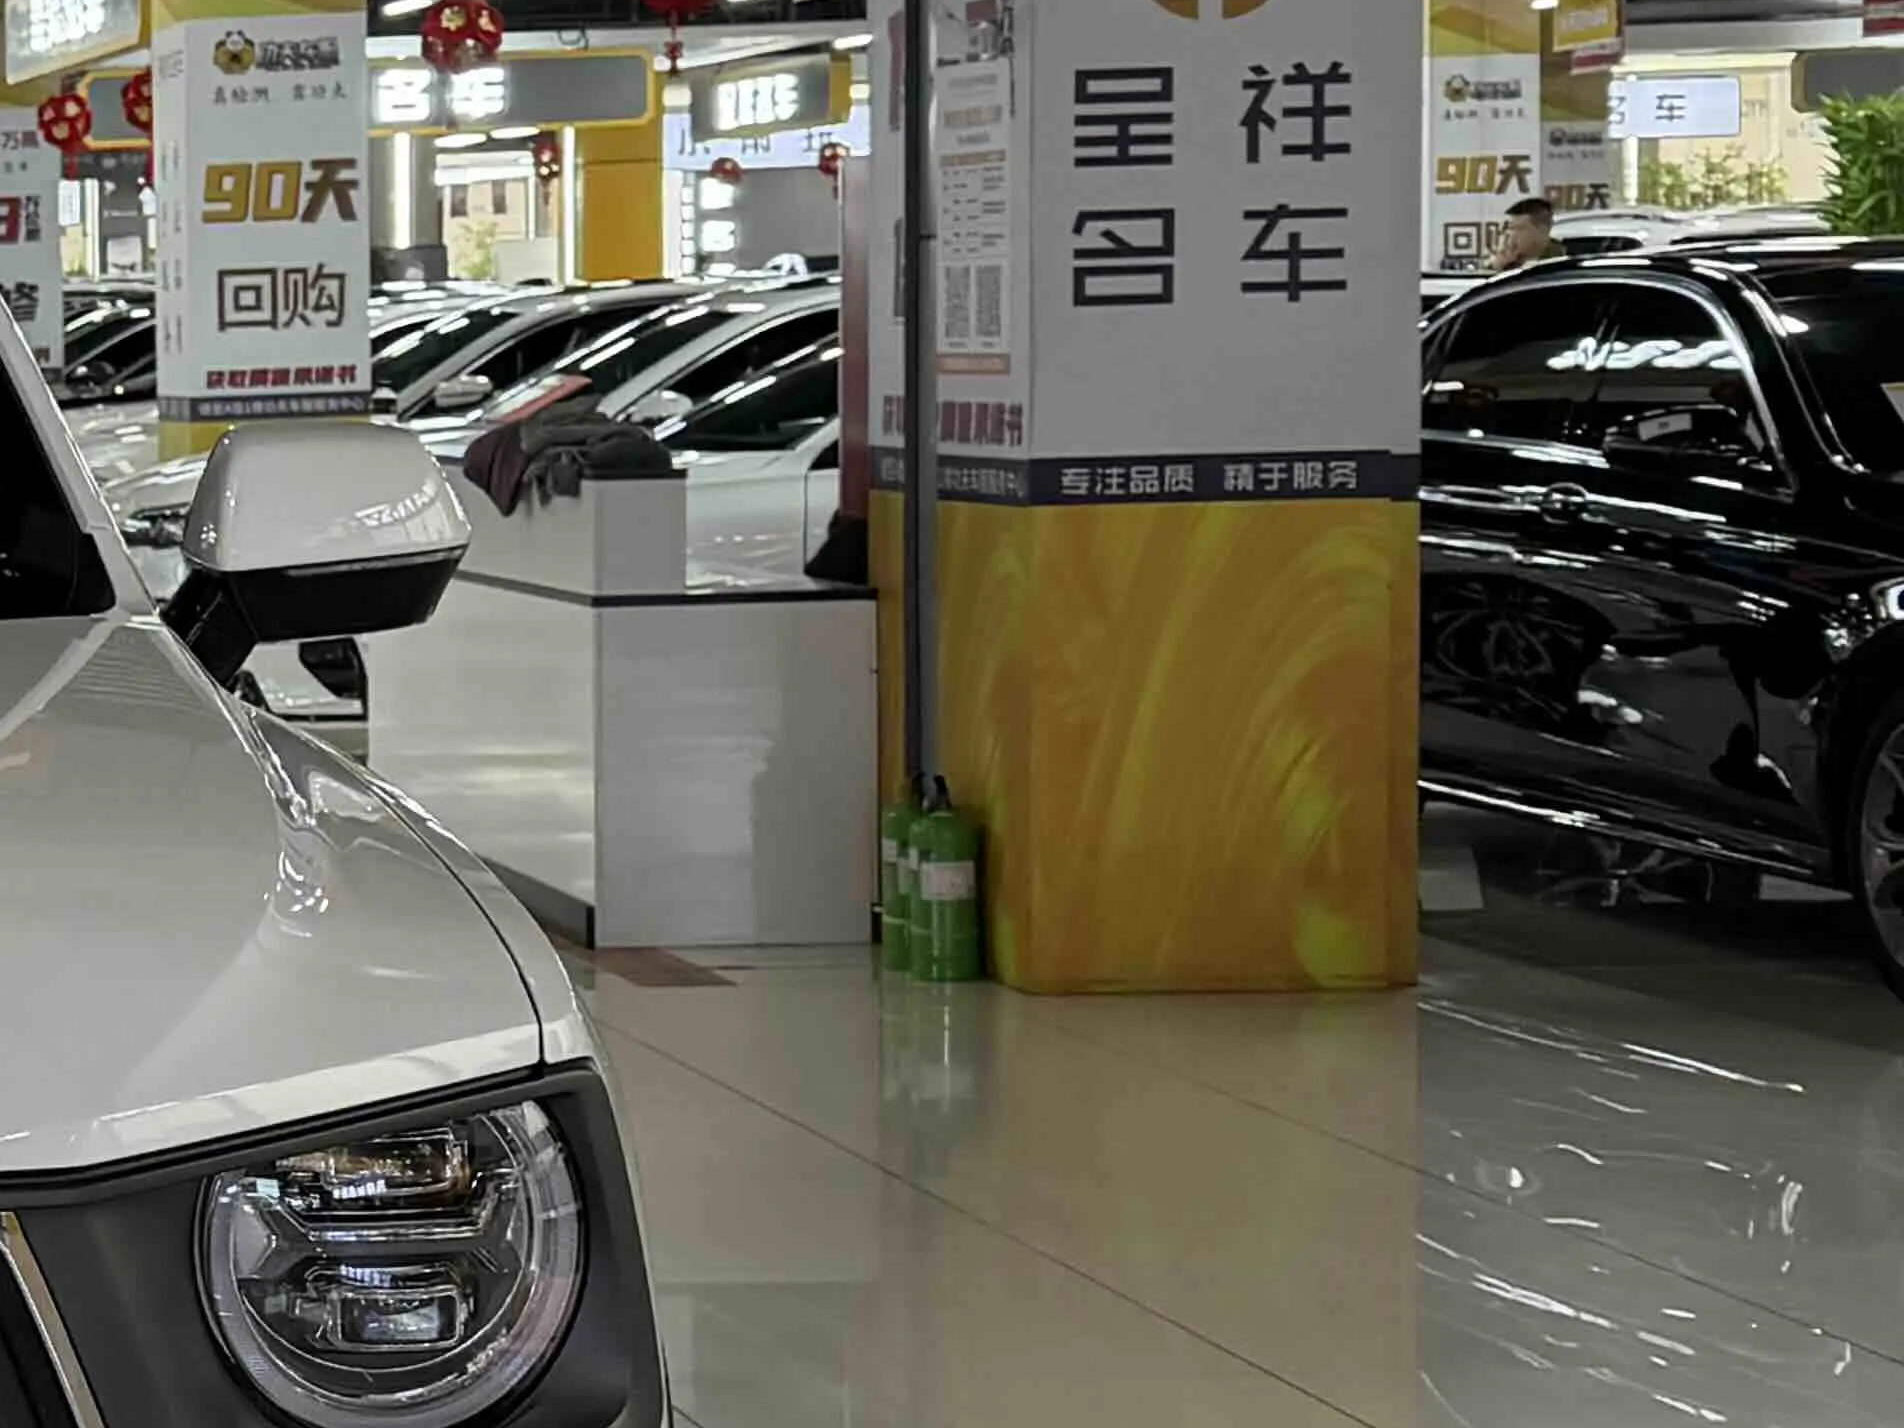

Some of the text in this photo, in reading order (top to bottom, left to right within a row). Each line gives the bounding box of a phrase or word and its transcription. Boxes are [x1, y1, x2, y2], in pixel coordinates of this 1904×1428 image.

[1073, 62, 1352, 168] 呈祥
[201, 157, 360, 224] 90天
[1434, 154, 1533, 195] 90天
[1071, 203, 1349, 308] 名车
[217, 263, 347, 332] 回购
[1060, 462, 1195, 498] 专注品质
[1222, 459, 1359, 493] 精于服务
